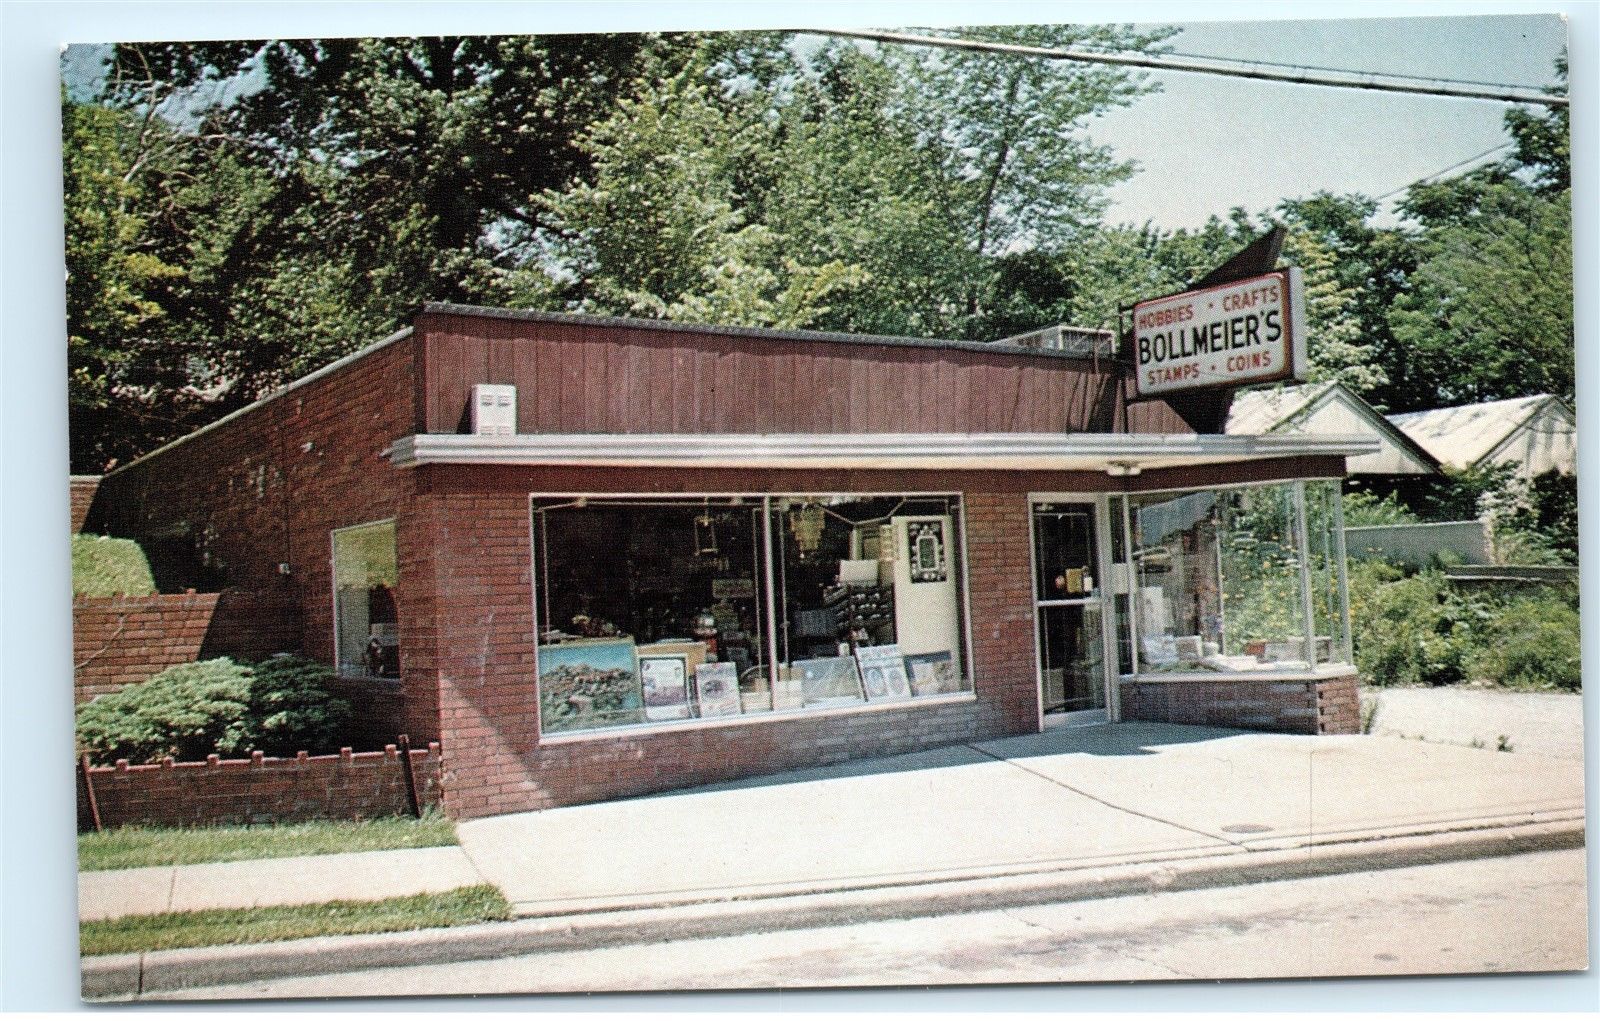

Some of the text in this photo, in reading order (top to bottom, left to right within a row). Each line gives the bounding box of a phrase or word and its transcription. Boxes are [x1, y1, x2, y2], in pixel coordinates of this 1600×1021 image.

[1139, 285, 1278, 329] HOBBIES CRAFTS
[1138, 310, 1282, 365] BOLLMEIER'S
[1149, 351, 1272, 385] STAMPS COINS
